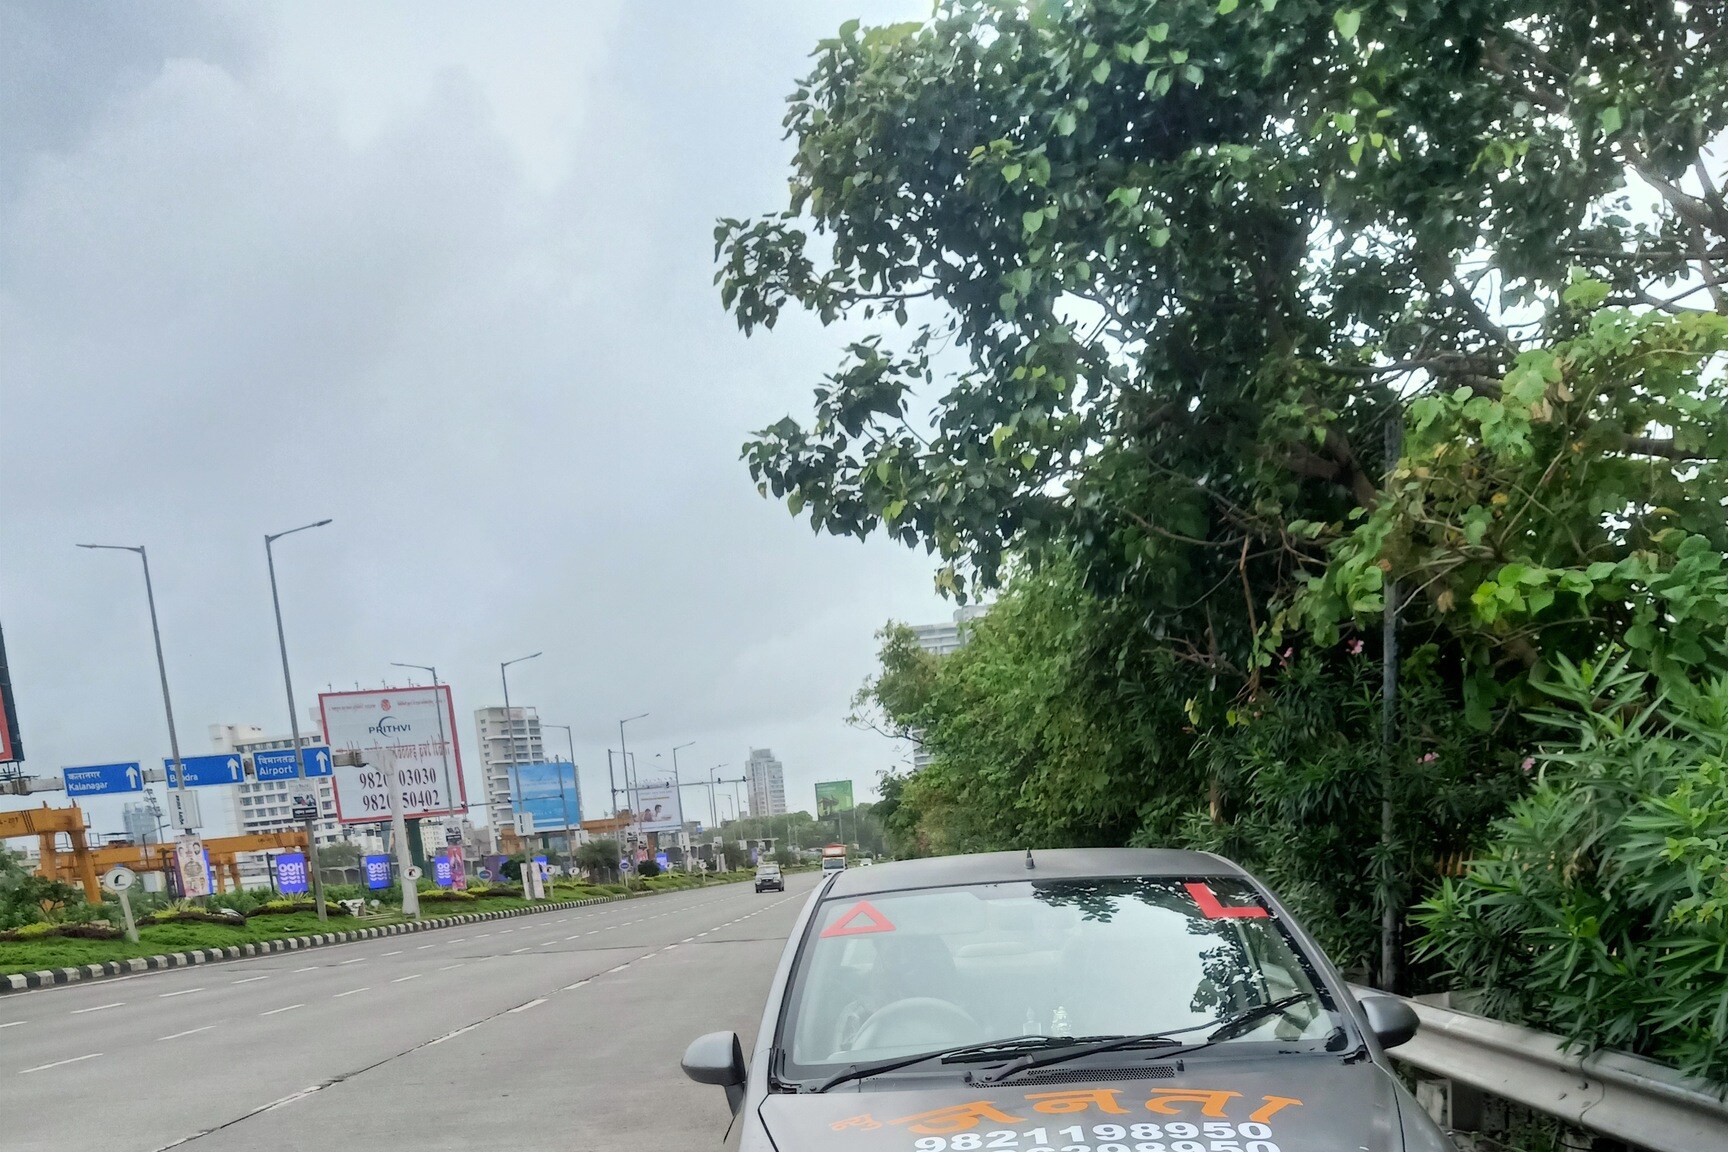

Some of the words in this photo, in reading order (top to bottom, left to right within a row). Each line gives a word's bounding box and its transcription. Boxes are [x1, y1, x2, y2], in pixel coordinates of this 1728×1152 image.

[368, 724, 411, 734] PRITHVI
[259, 765, 293, 777] Airport
[170, 773, 199, 783] Bdra
[360, 767, 437, 789] 98203030
[68, 781, 108, 792] Kalanagar
[363, 789, 440, 812] 98250402
[889, 1087, 1303, 1134] जनता
